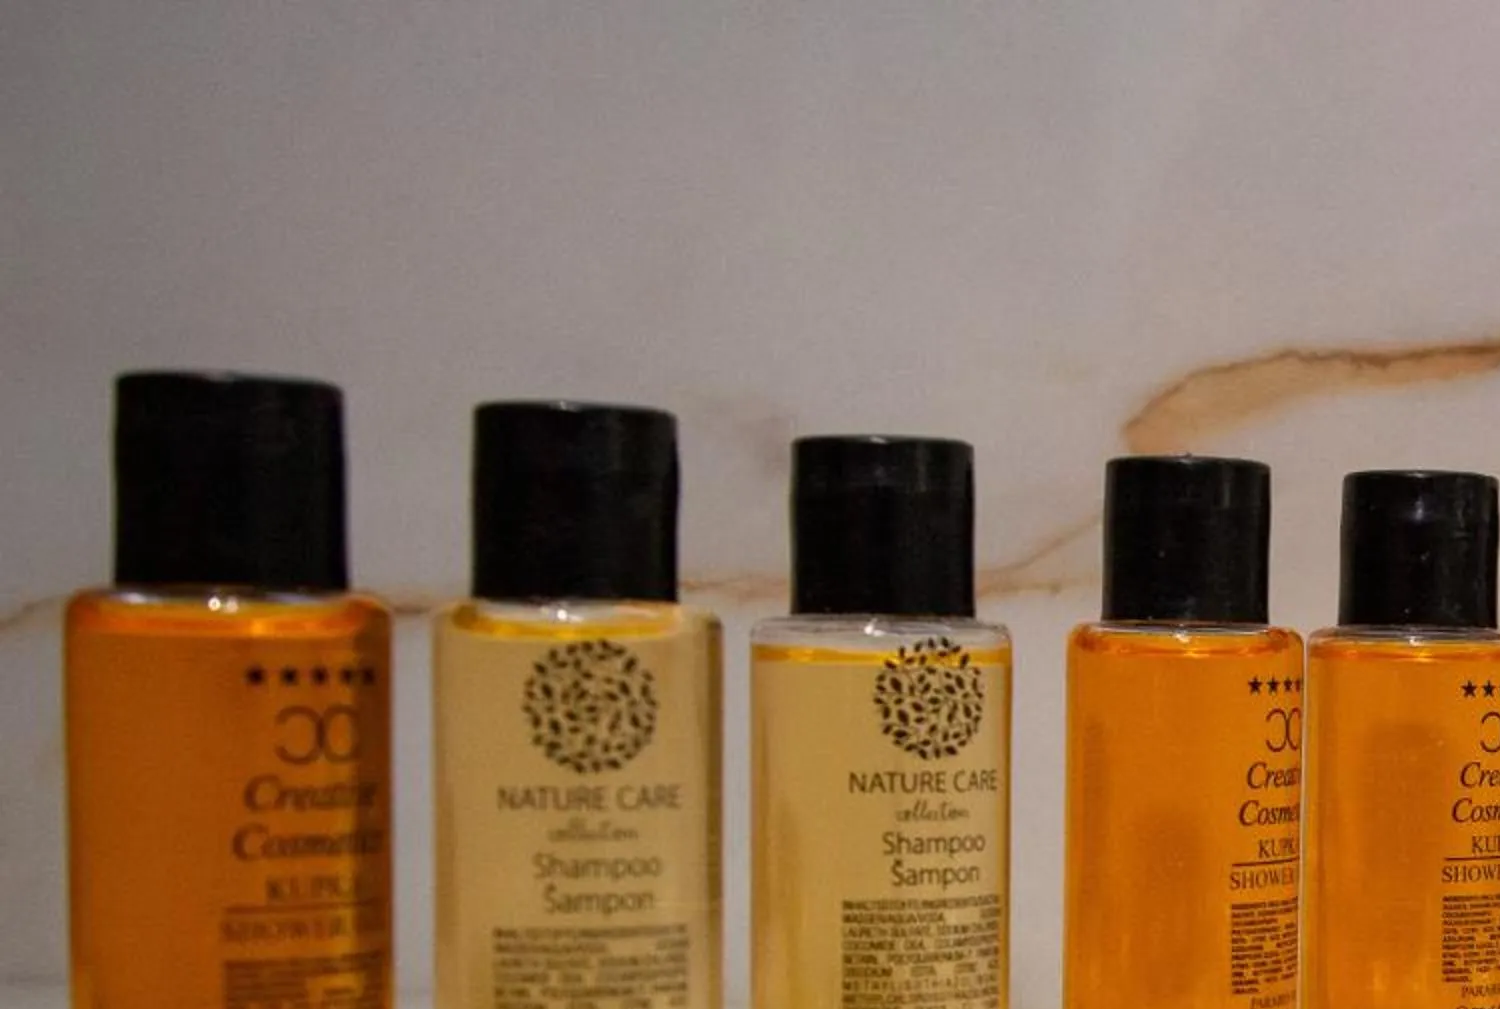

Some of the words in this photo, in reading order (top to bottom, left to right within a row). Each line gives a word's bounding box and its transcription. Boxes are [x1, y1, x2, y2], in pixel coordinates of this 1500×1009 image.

[849, 771, 946, 793] NATURE
[953, 770, 997, 792] CARE
[497, 785, 608, 811] NATURE
[616, 783, 683, 811] CARE
[882, 831, 986, 858] Shampoo
[532, 852, 662, 882] Shampoo
[891, 859, 980, 890] Šampon
